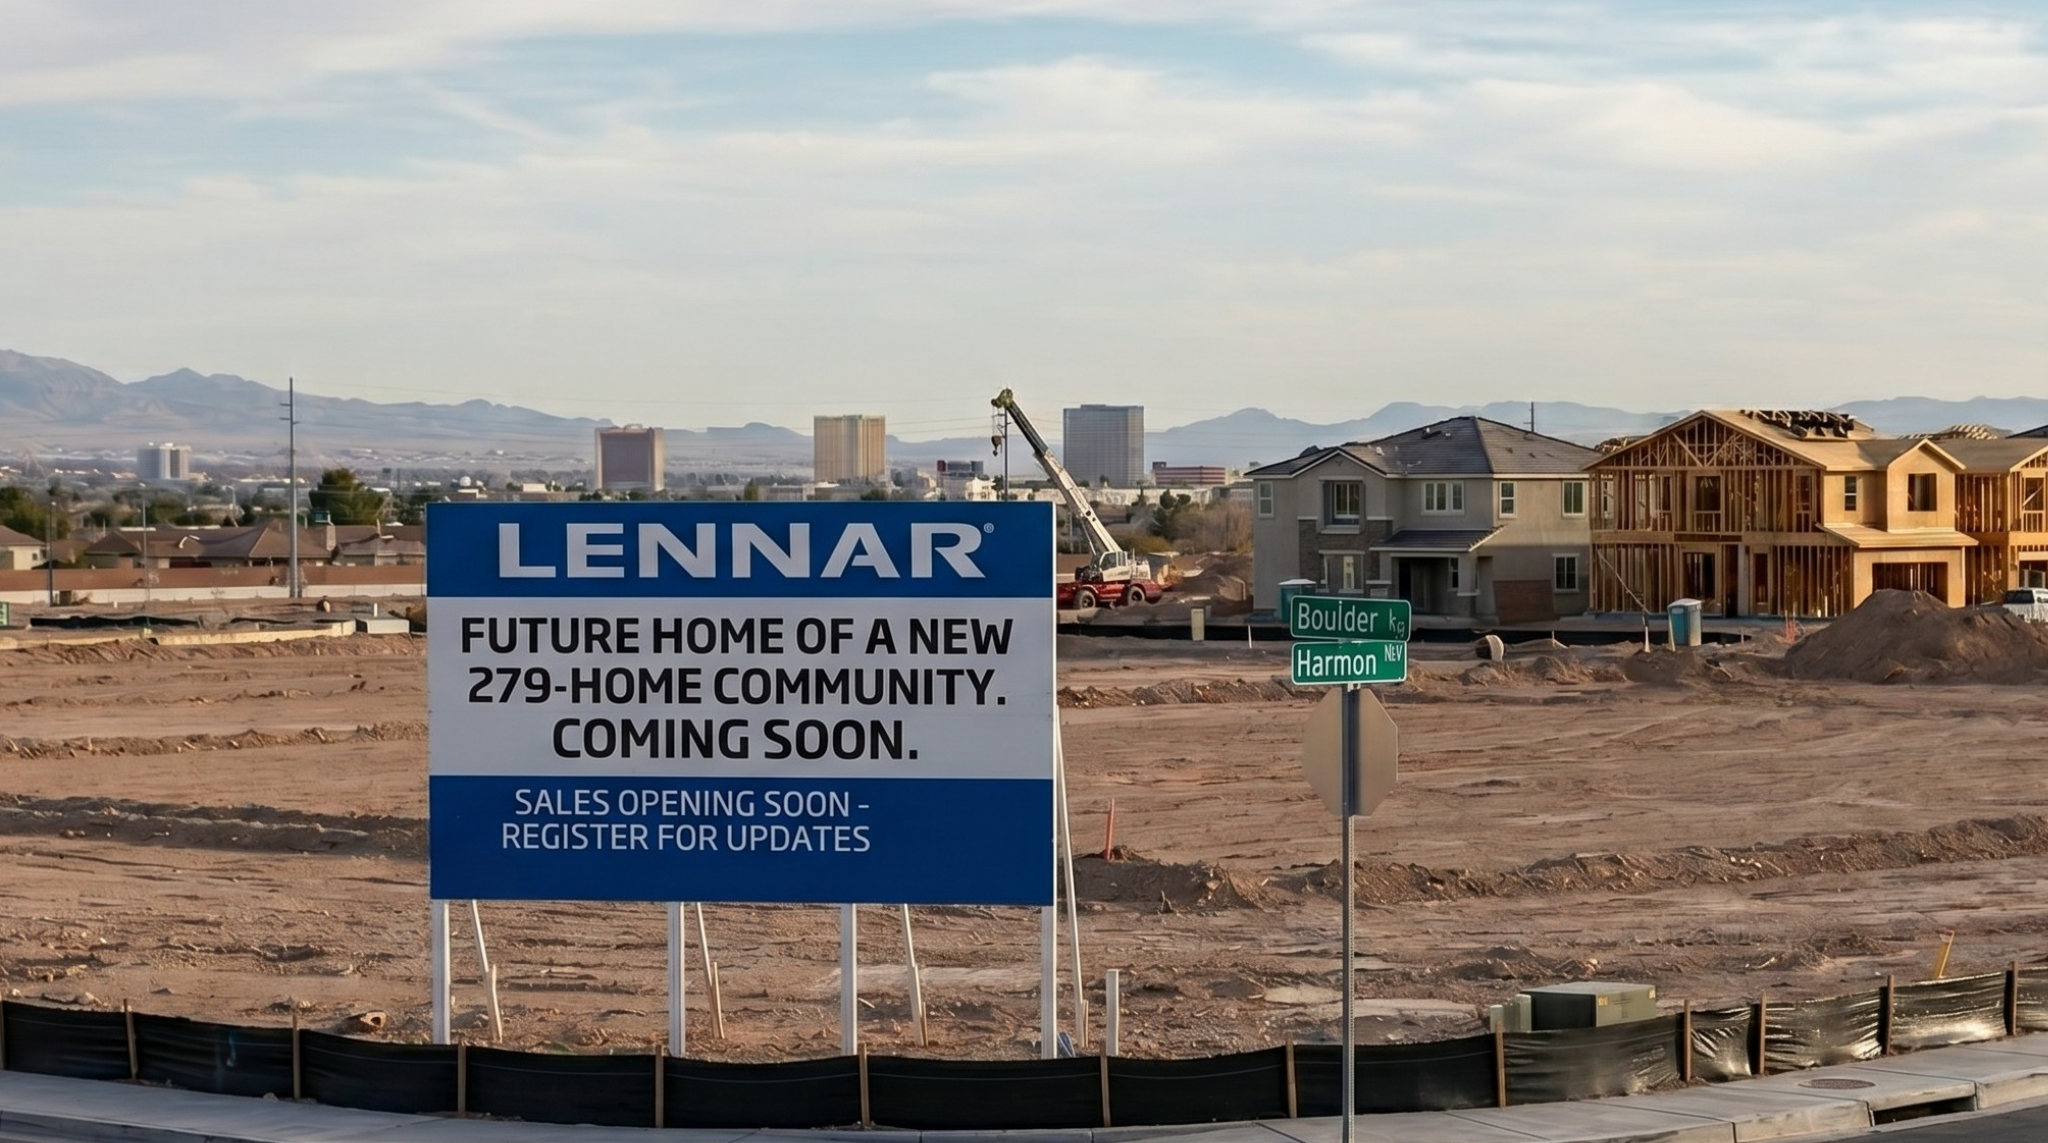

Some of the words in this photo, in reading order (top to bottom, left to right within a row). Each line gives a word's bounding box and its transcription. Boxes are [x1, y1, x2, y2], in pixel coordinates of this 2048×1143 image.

[461, 616, 640, 655] FUTURE
[652, 616, 784, 655] HOME
[796, 616, 854, 655] OF
[864, 617, 897, 655] A
[909, 617, 1014, 655] NEW
[1297, 649, 1377, 678] Harmon
[468, 666, 702, 705] 279-HOME
[713, 667, 1006, 706] COMMUNITY.
[552, 717, 749, 760] COMING
[763, 718, 918, 760] SOON.
[515, 788, 610, 816] SALES
[618, 789, 754, 817] OPENING
[764, 790, 849, 817] SOON
[503, 823, 649, 850] REGISTER
[658, 824, 718, 851] FOR
[727, 825, 870, 852] UPDATES
